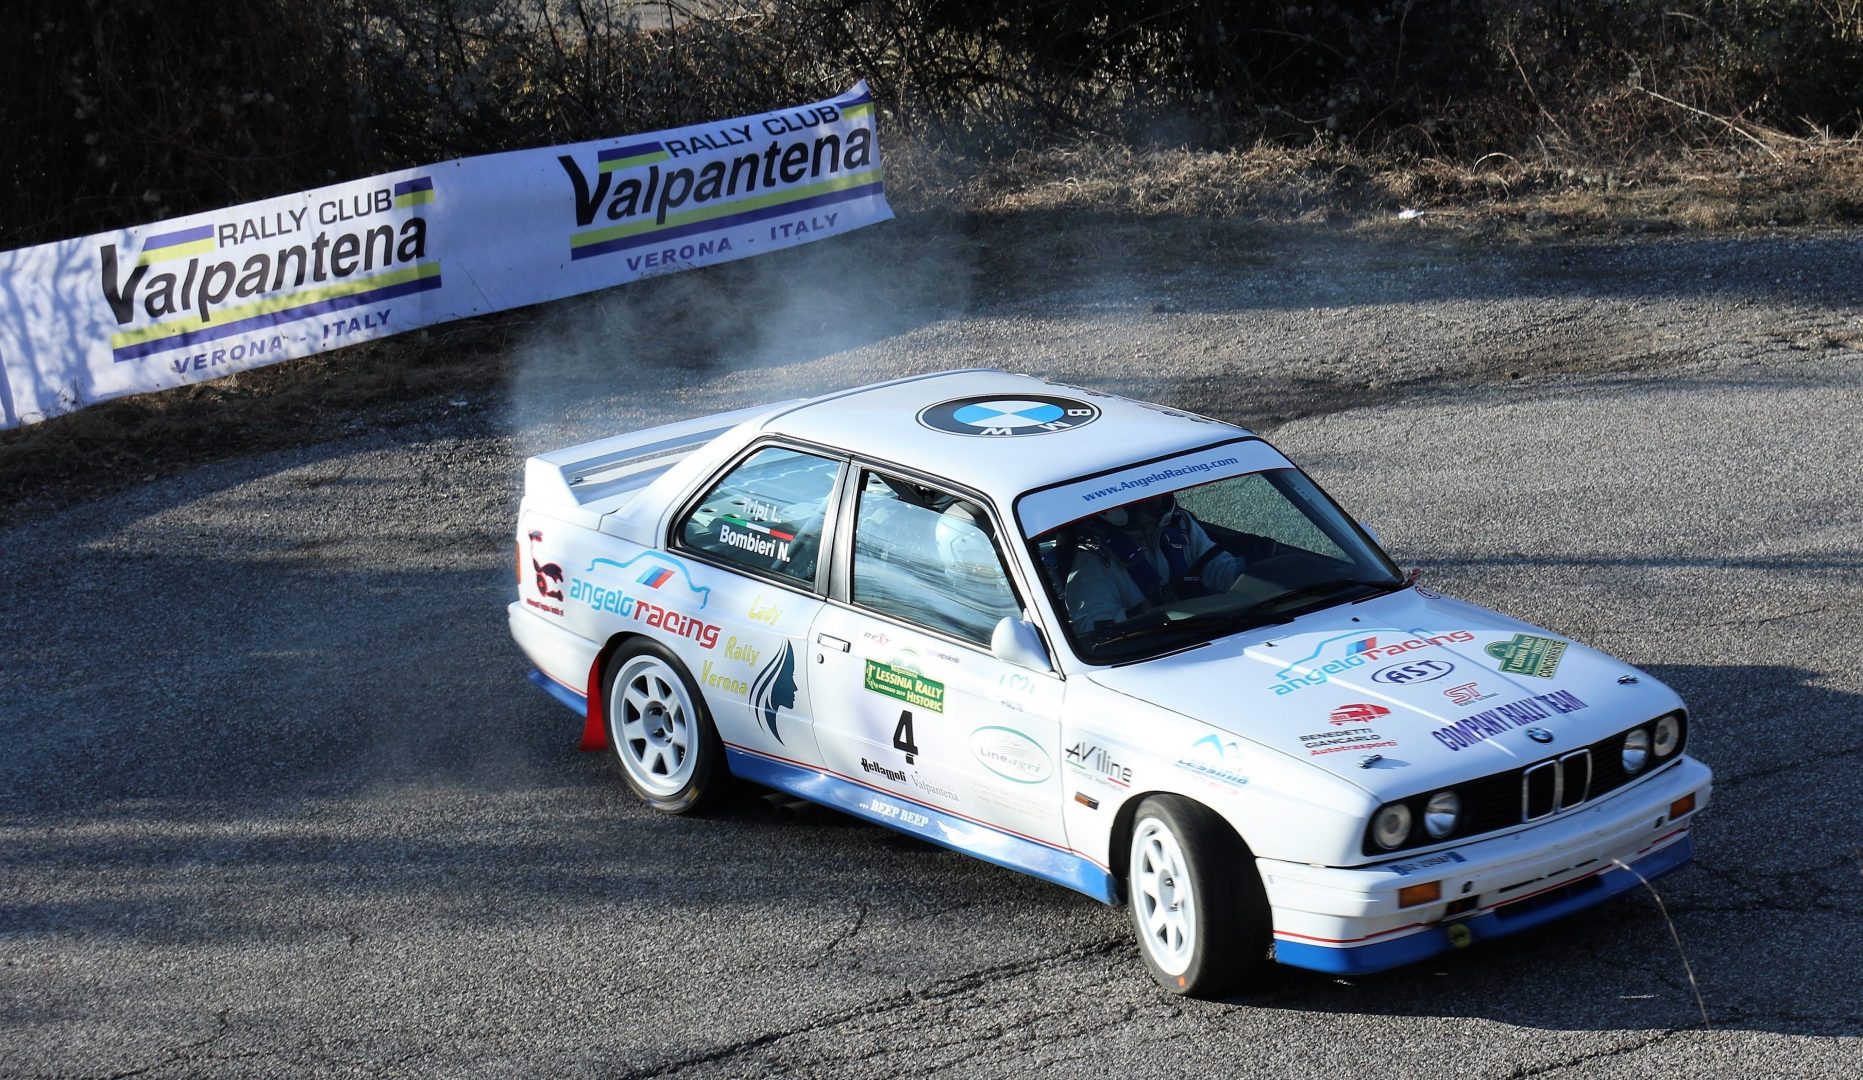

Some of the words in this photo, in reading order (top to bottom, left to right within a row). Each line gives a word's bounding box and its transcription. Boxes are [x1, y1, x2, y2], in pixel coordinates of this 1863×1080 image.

[665, 124, 752, 158] RALLY
[762, 104, 841, 137] CLUB
[557, 127, 872, 227] Valpantena
[217, 206, 308, 248] RALLY
[318, 188, 393, 226] CLUB
[625, 236, 733, 272] VERONA
[770, 212, 839, 242] ITALY
[100, 216, 427, 325] Valpantena
[174, 335, 283, 375] VERONA
[322, 309, 392, 339] ITALY
[1082, 456, 1239, 502] www.AngeloRacing.com
[742, 497, 770, 521] Tripi
[770, 505, 782, 524] L.
[719, 524, 777, 558] Bombieri
[776, 541, 791, 563] N.
[724, 635, 761, 667] Rally
[702, 659, 748, 696] Verona
[875, 666, 914, 691] LESSINIA
[914, 679, 943, 700] RALLY
[1385, 660, 1444, 684] AST
[905, 690, 944, 713] HISTORIC
[893, 709, 919, 766] 4
[1299, 728, 1374, 742] BENEDETTI
[1431, 709, 1515, 752] COMPANY
[1494, 697, 1552, 727] RALLY
[1532, 689, 1589, 715] TEAM
[980, 747, 1042, 773] Lineagri
[1304, 734, 1382, 749] GIANCARLO
[910, 773, 960, 801] Valpantena
[870, 798, 900, 818] BEEP
[899, 808, 930, 828] BEEP
